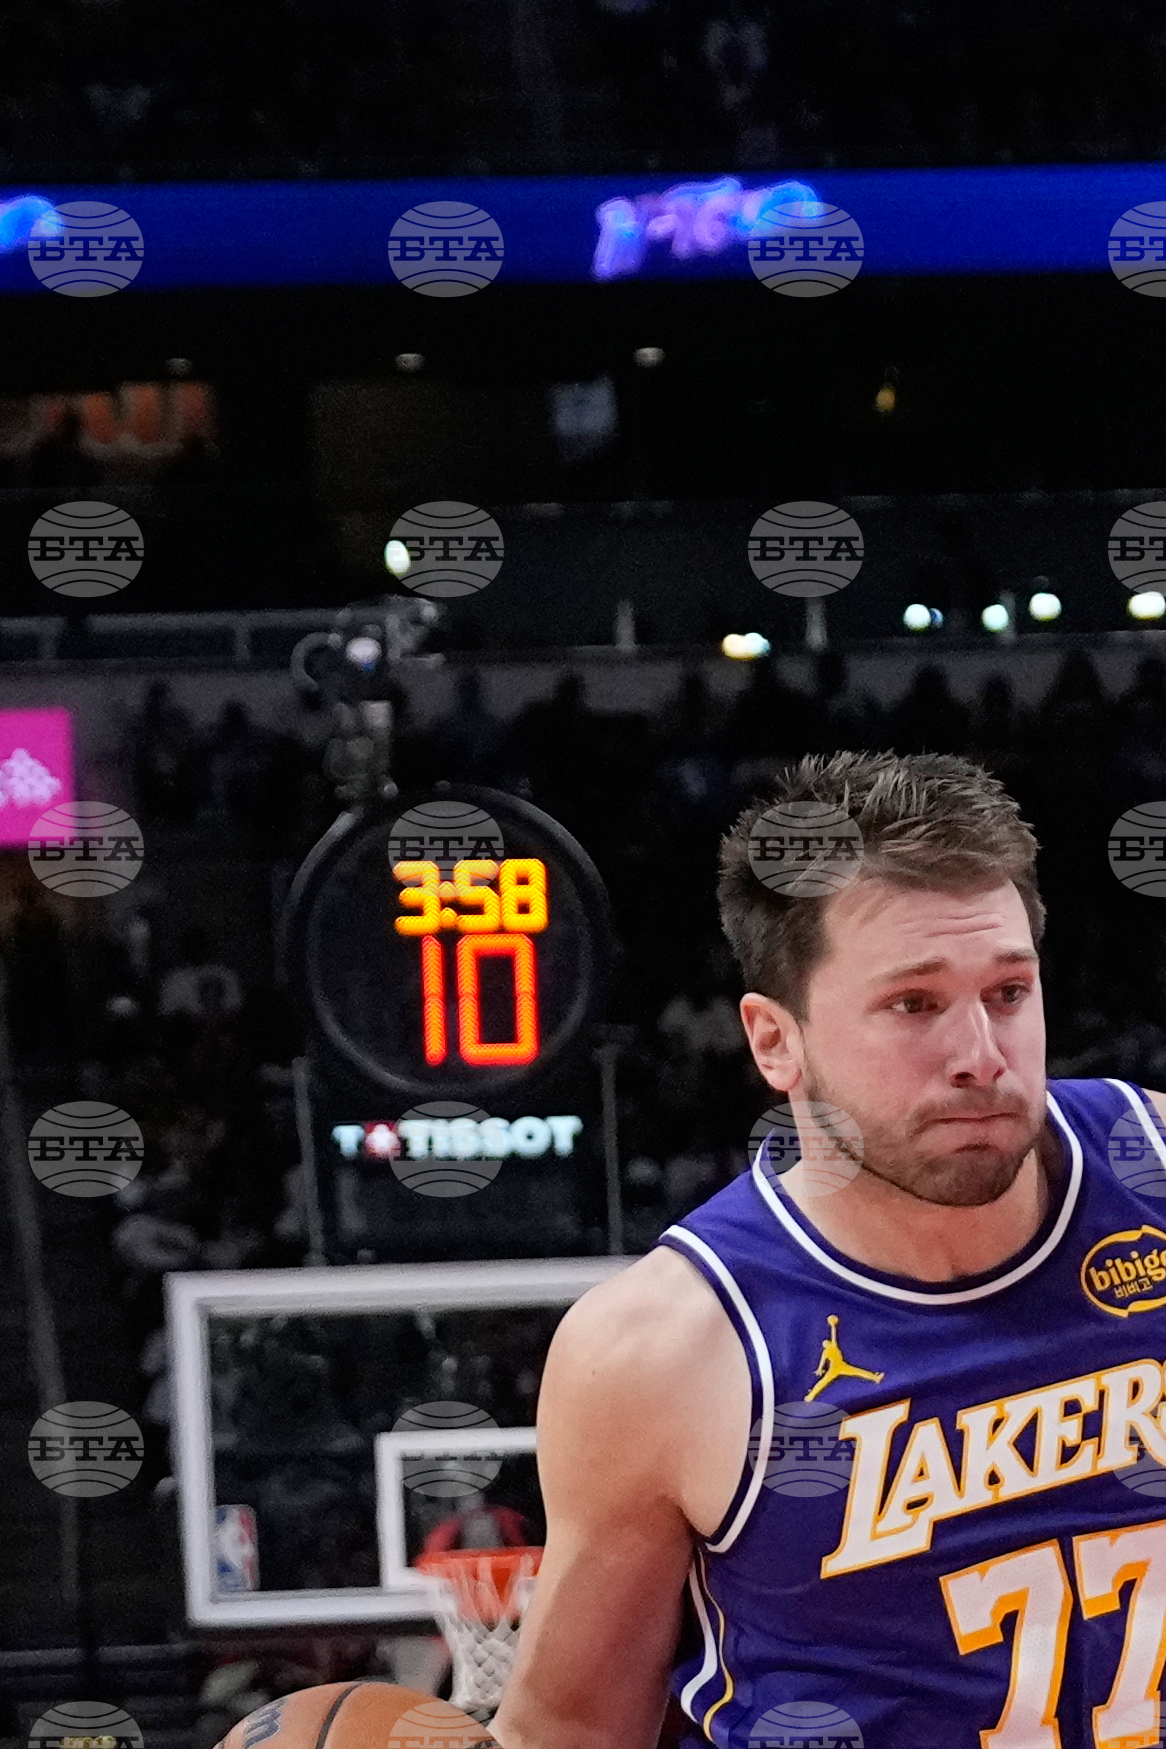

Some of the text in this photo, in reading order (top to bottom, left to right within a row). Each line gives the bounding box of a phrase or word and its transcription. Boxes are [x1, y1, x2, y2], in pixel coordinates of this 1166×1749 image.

[393, 857, 549, 936] 3:58
[420, 932, 542, 1067] 10
[398, 1115, 584, 1160] TISSOT
[1113, 1277, 1154, 1299] 비비고
